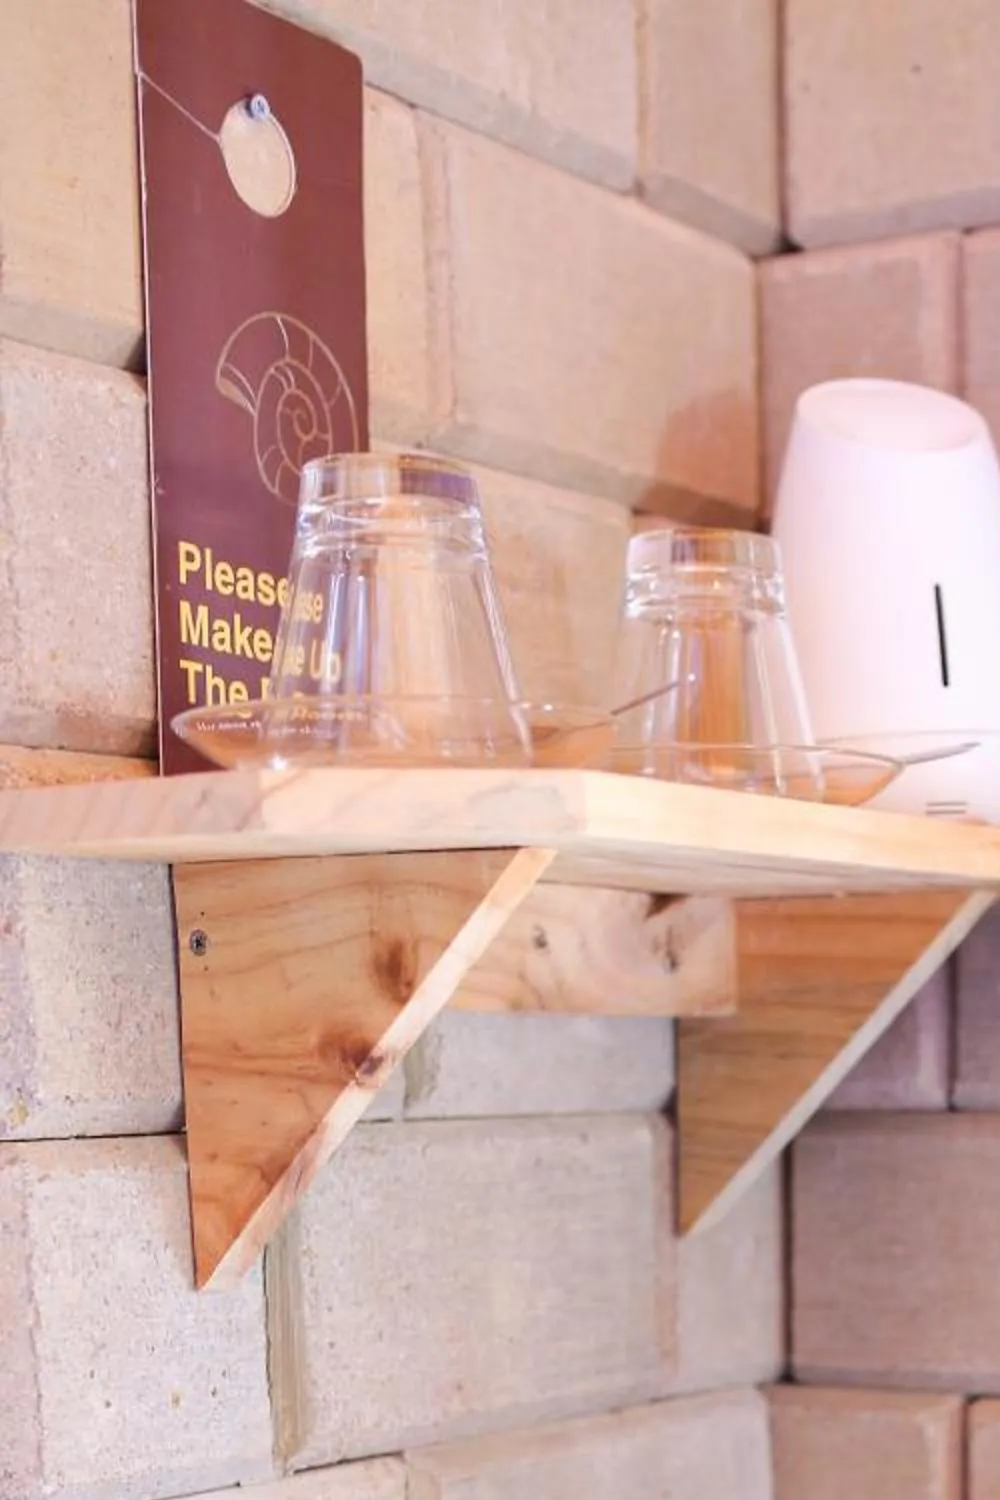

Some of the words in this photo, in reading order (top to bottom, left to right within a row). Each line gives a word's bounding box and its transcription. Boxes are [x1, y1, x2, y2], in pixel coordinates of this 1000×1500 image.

[177, 541, 295, 609] Please
[179, 600, 273, 663] Make
[179, 659, 252, 718] The
